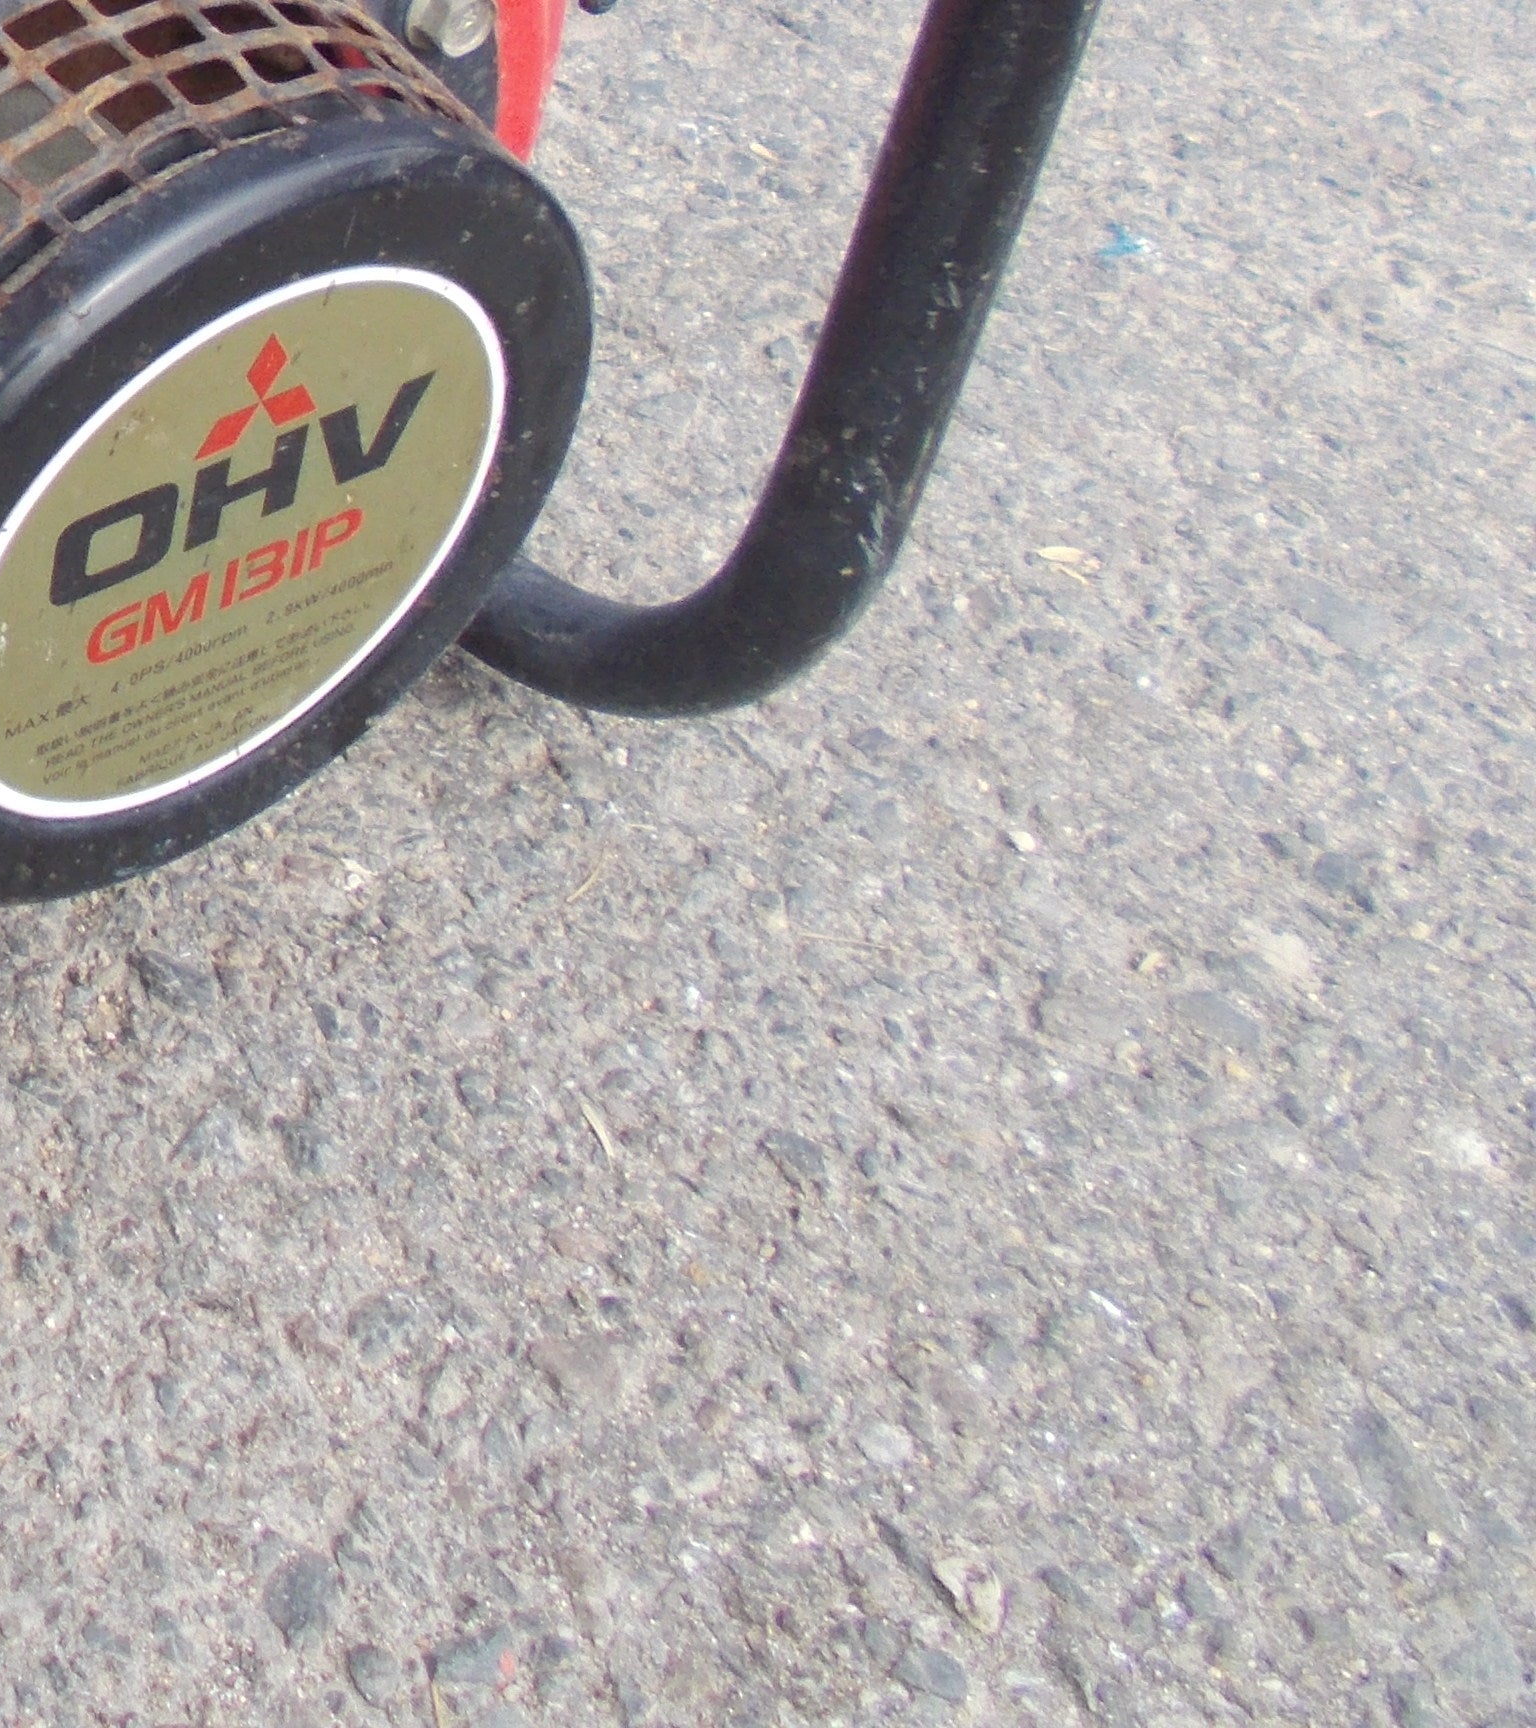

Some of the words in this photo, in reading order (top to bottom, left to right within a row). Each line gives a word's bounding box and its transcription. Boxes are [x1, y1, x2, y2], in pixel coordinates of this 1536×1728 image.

[48, 369, 436, 607] OHV
[85, 508, 364, 665] GM131P
[2, 710, 50, 741] MAX
